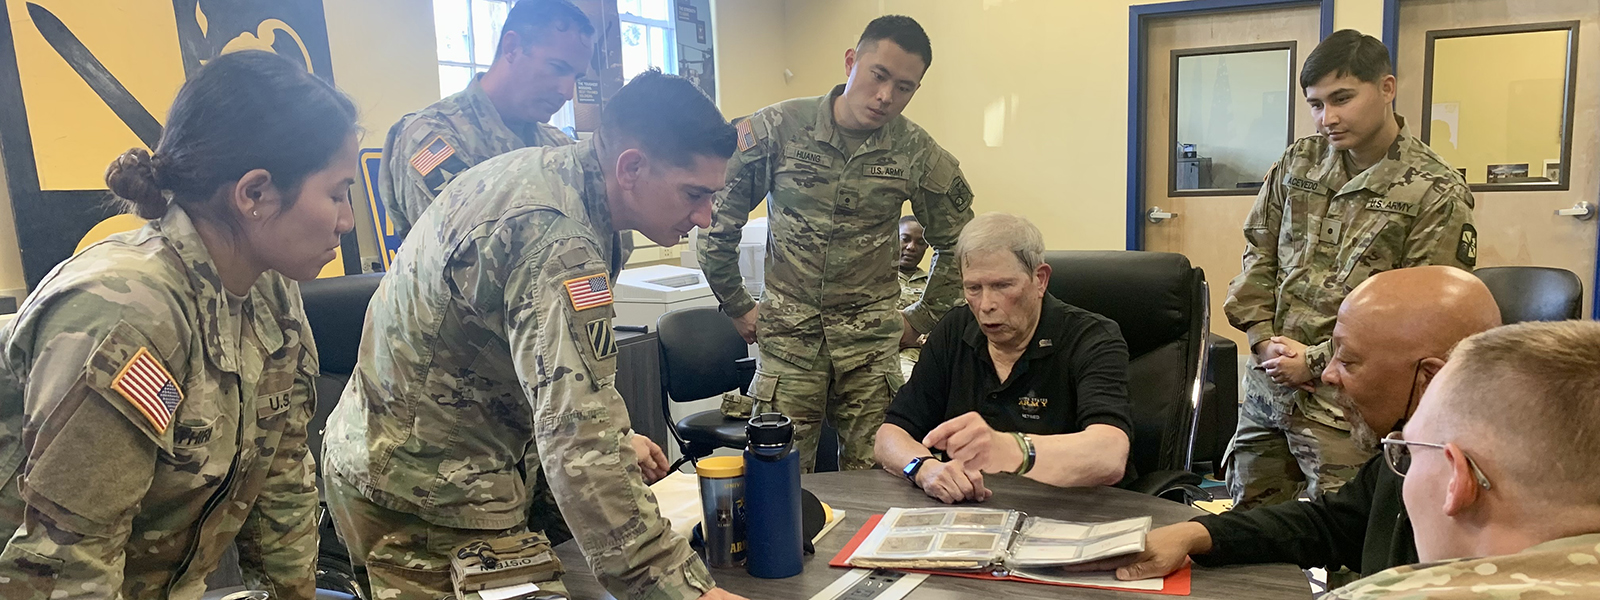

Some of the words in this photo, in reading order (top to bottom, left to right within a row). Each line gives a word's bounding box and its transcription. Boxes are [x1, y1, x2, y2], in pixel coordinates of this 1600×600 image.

[795, 150, 822, 163] HUANG
[885, 168, 904, 178] ARMY
[1287, 177, 1318, 190] ACEVEDO
[1385, 201, 1413, 213] ARMY
[480, 559, 532, 572] O'STEN
